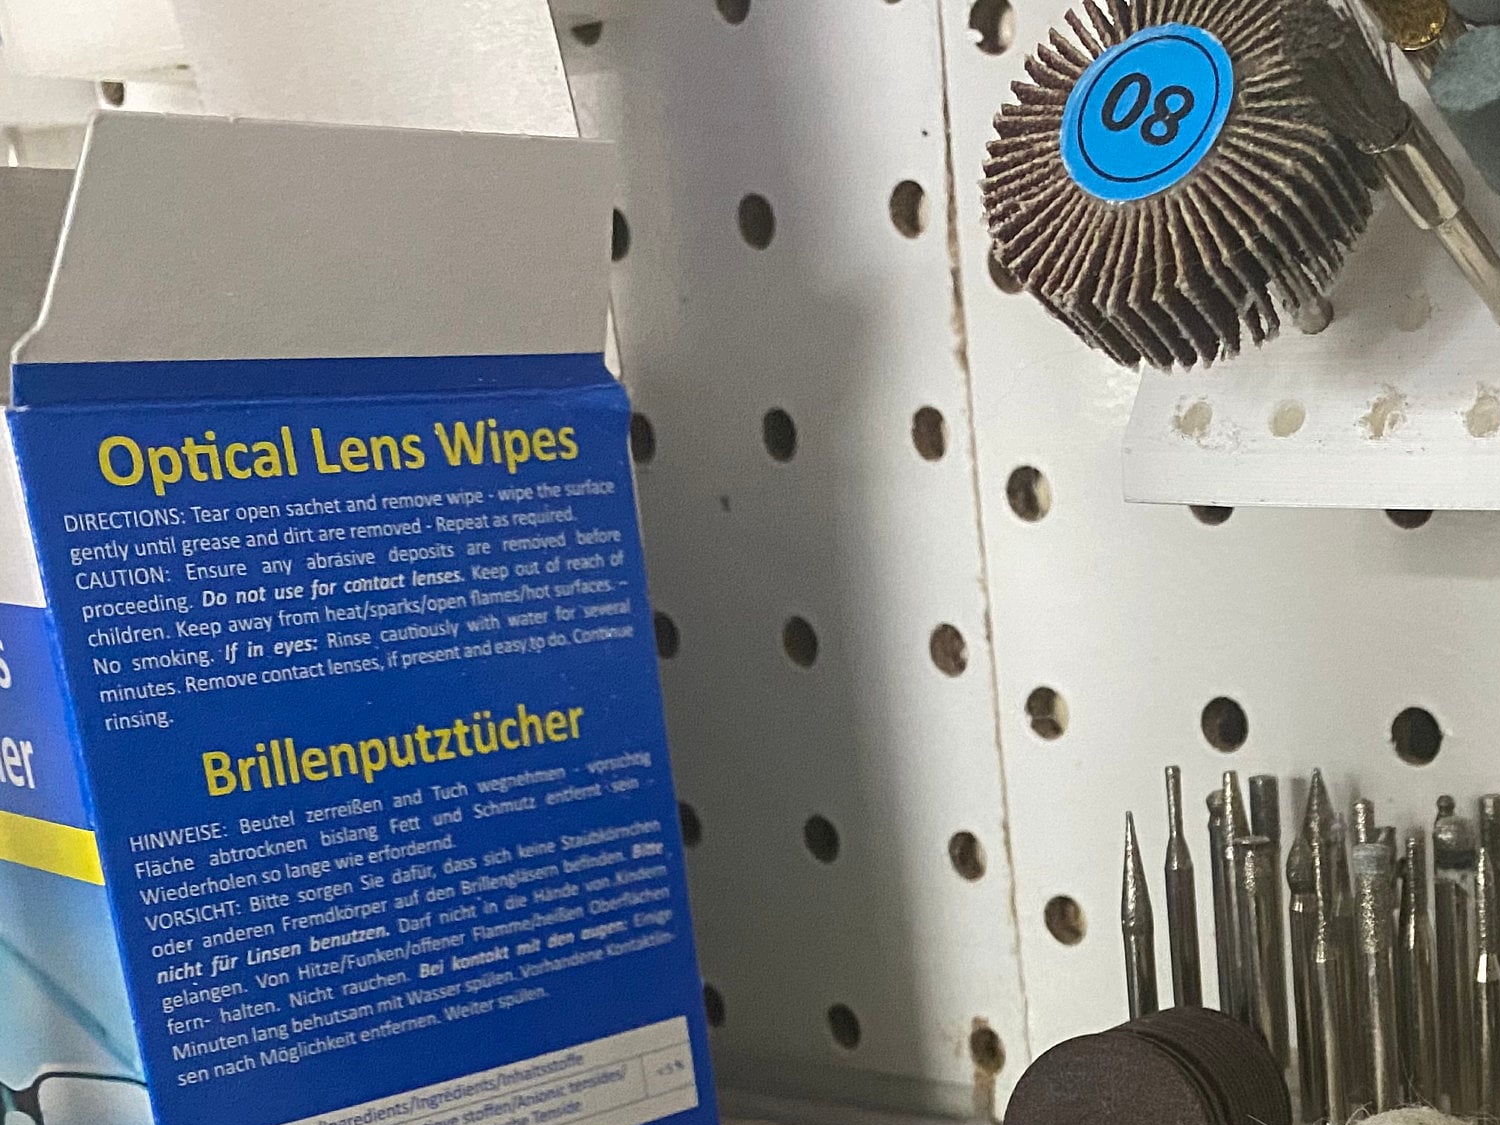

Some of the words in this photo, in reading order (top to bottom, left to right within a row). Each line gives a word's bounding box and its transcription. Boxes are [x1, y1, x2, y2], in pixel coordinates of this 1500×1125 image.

[99, 426, 297, 496] Optical
[311, 427, 425, 475] Lens
[434, 418, 578, 473] Wipes
[64, 508, 185, 532] DIRECTIONS:
[190, 506, 229, 522] Tear
[236, 505, 280, 523] open
[286, 498, 341, 516] sachet
[346, 494, 377, 512] and
[382, 494, 442, 509] remove
[446, 491, 483, 506] wipe
[498, 488, 533, 502] wipe
[70, 540, 128, 565] gently
[135, 537, 176, 556] until
[182, 536, 240, 556] grease
[246, 529, 279, 547] and
[284, 527, 314, 544] dirt
[319, 528, 345, 541] are
[350, 518, 421, 538] removed
[436, 515, 489, 533] Repeat
[76, 567, 170, 590] CAUTION:
[186, 563, 247, 580] Ensure
[262, 560, 292, 575] any
[307, 552, 375, 569] abrasive
[389, 543, 454, 563] deposits
[467, 542, 490, 555] are
[82, 595, 193, 622] proceeding.
[203, 591, 227, 607] Do
[236, 587, 266, 603] not
[275, 586, 303, 600] use
[311, 579, 336, 600] for
[344, 574, 405, 593] contact
[471, 565, 508, 580] Keep
[88, 626, 170, 647] children.
[176, 621, 221, 637] Keep
[229, 617, 272, 632] away
[278, 610, 319, 626] from
[325, 595, 466, 621] heat/sparks/open
[93, 658, 121, 675] No
[132, 649, 214, 671] smoking.
[225, 642, 238, 664] If
[248, 641, 263, 657] in
[274, 639, 317, 657] eyes:
[327, 633, 371, 648] Rinse
[380, 620, 459, 642] cautiously
[467, 615, 500, 631] with
[100, 682, 180, 702] minutes.
[185, 673, 257, 692] Remove
[262, 663, 325, 683] contact
[327, 658, 384, 675] lenses,
[387, 651, 398, 668] if
[401, 646, 461, 669] present
[464, 640, 492, 658] and
[105, 711, 173, 731] rinsing.
[203, 704, 583, 796] Brillenputztücher
[0, 737, 35, 789] er
[130, 823, 227, 852] HINWEISE:
[239, 810, 295, 834] Beutel
[306, 799, 383, 823] zerreißen
[430, 782, 468, 800] Tuch
[135, 857, 194, 879] Fläche
[210, 839, 307, 866] abtrocknen
[320, 826, 379, 846] bislang
[390, 817, 420, 833] Fett
[433, 807, 462, 826] und
[140, 874, 257, 905] Wiederholen
[262, 870, 281, 883] so
[285, 861, 331, 878] lange
[335, 854, 363, 869] wie
[145, 900, 241, 931] VORSICHT:
[250, 894, 289, 912] Bitte
[297, 882, 353, 902] sorgen
[360, 874, 384, 890] Sie
[443, 858, 477, 874] dass
[152, 939, 193, 957] oder
[203, 924, 274, 947] anderen
[282, 901, 387, 931] Fremdkörper
[394, 889, 419, 909] auf
[426, 887, 455, 902] den
[157, 962, 202, 984] nicht
[211, 955, 238, 977] für
[247, 944, 301, 965] Linsen
[310, 926, 390, 952] benutzen.
[397, 912, 431, 933] Darf
[438, 904, 478, 924] nicht
[167, 1018, 210, 1035] fern-
[220, 1002, 280, 1023] halten.
[289, 987, 334, 1008] Nicht
[420, 960, 443, 978] Bei
[255, 972, 289, 988] Von
[172, 1034, 248, 1060] Minuten
[252, 1024, 289, 1042] lang
[291, 1005, 373, 1033] behutsam
[406, 984, 460, 1005] Wasser
[178, 1069, 209, 1086] sen
[214, 1055, 256, 1077] nach
[260, 1032, 357, 1066] Möglichkeit
